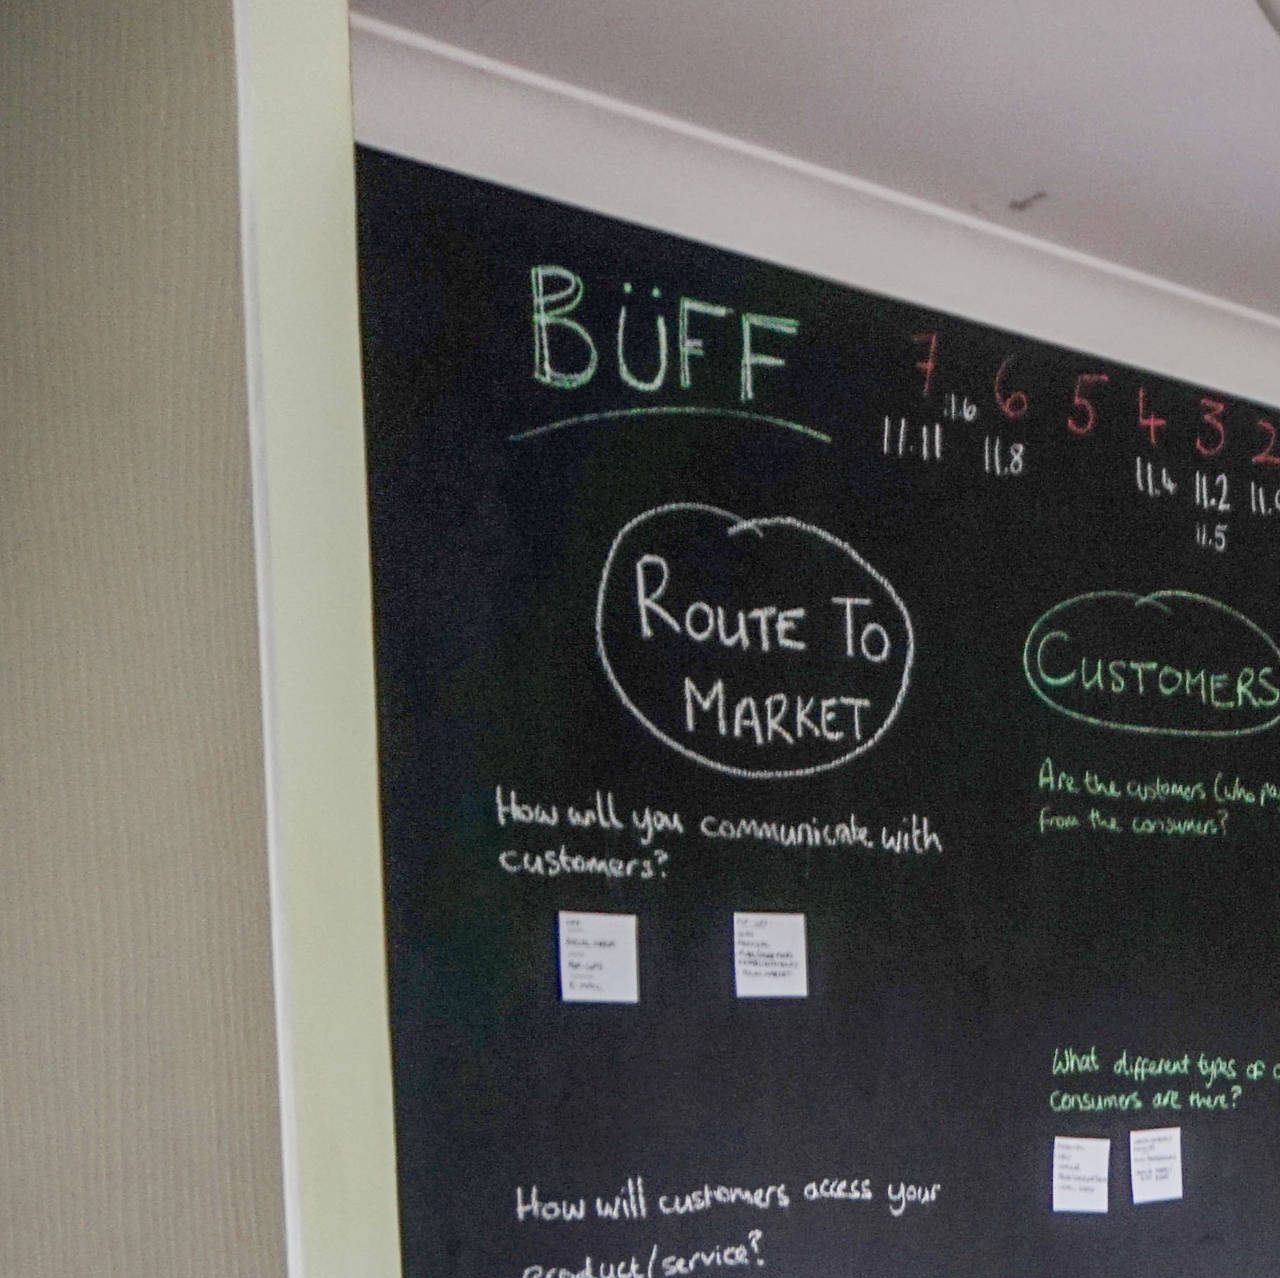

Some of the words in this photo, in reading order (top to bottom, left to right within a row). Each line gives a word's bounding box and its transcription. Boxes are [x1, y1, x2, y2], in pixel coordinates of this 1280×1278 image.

[531, 264, 799, 399] BÜFF
[912, 333, 937, 396] 7
[994, 354, 1028, 420] 6
[1067, 373, 1109, 435] 5
[1138, 387, 1166, 446] 4
[1196, 398, 1224, 455] 3
[883, 415, 942, 461] 11.11
[984, 435, 1024, 475] 11.8
[1136, 456, 1177, 496] 11.4
[1196, 470, 1230, 510] 11.2
[1196, 524, 1228, 551] 11.5
[636, 554, 804, 651] ROUTE
[1038, 631, 1280, 708] CUSTOMERS
[684, 677, 870, 744] MARKET
[1038, 756, 1081, 794] Are
[1084, 770, 1121, 798] the
[496, 785, 559, 826] How
[567, 789, 625, 829] will
[632, 807, 685, 846] you
[700, 815, 874, 848] communicate
[880, 813, 943, 853] with
[1038, 806, 1080, 834] from
[1089, 807, 1123, 833] the
[499, 844, 669, 879] customers?
[1052, 1047, 1099, 1075] What
[1114, 1049, 1190, 1081] different
[1198, 1054, 1237, 1088] types
[1247, 1060, 1264, 1081] of
[1152, 1092, 1183, 1110] are
[1189, 1085, 1243, 1110] there?
[516, 1184, 585, 1223] How
[596, 1176, 646, 1219] will
[659, 1182, 790, 1217] customers
[803, 1178, 872, 1201] access
[887, 1181, 942, 1217] your
